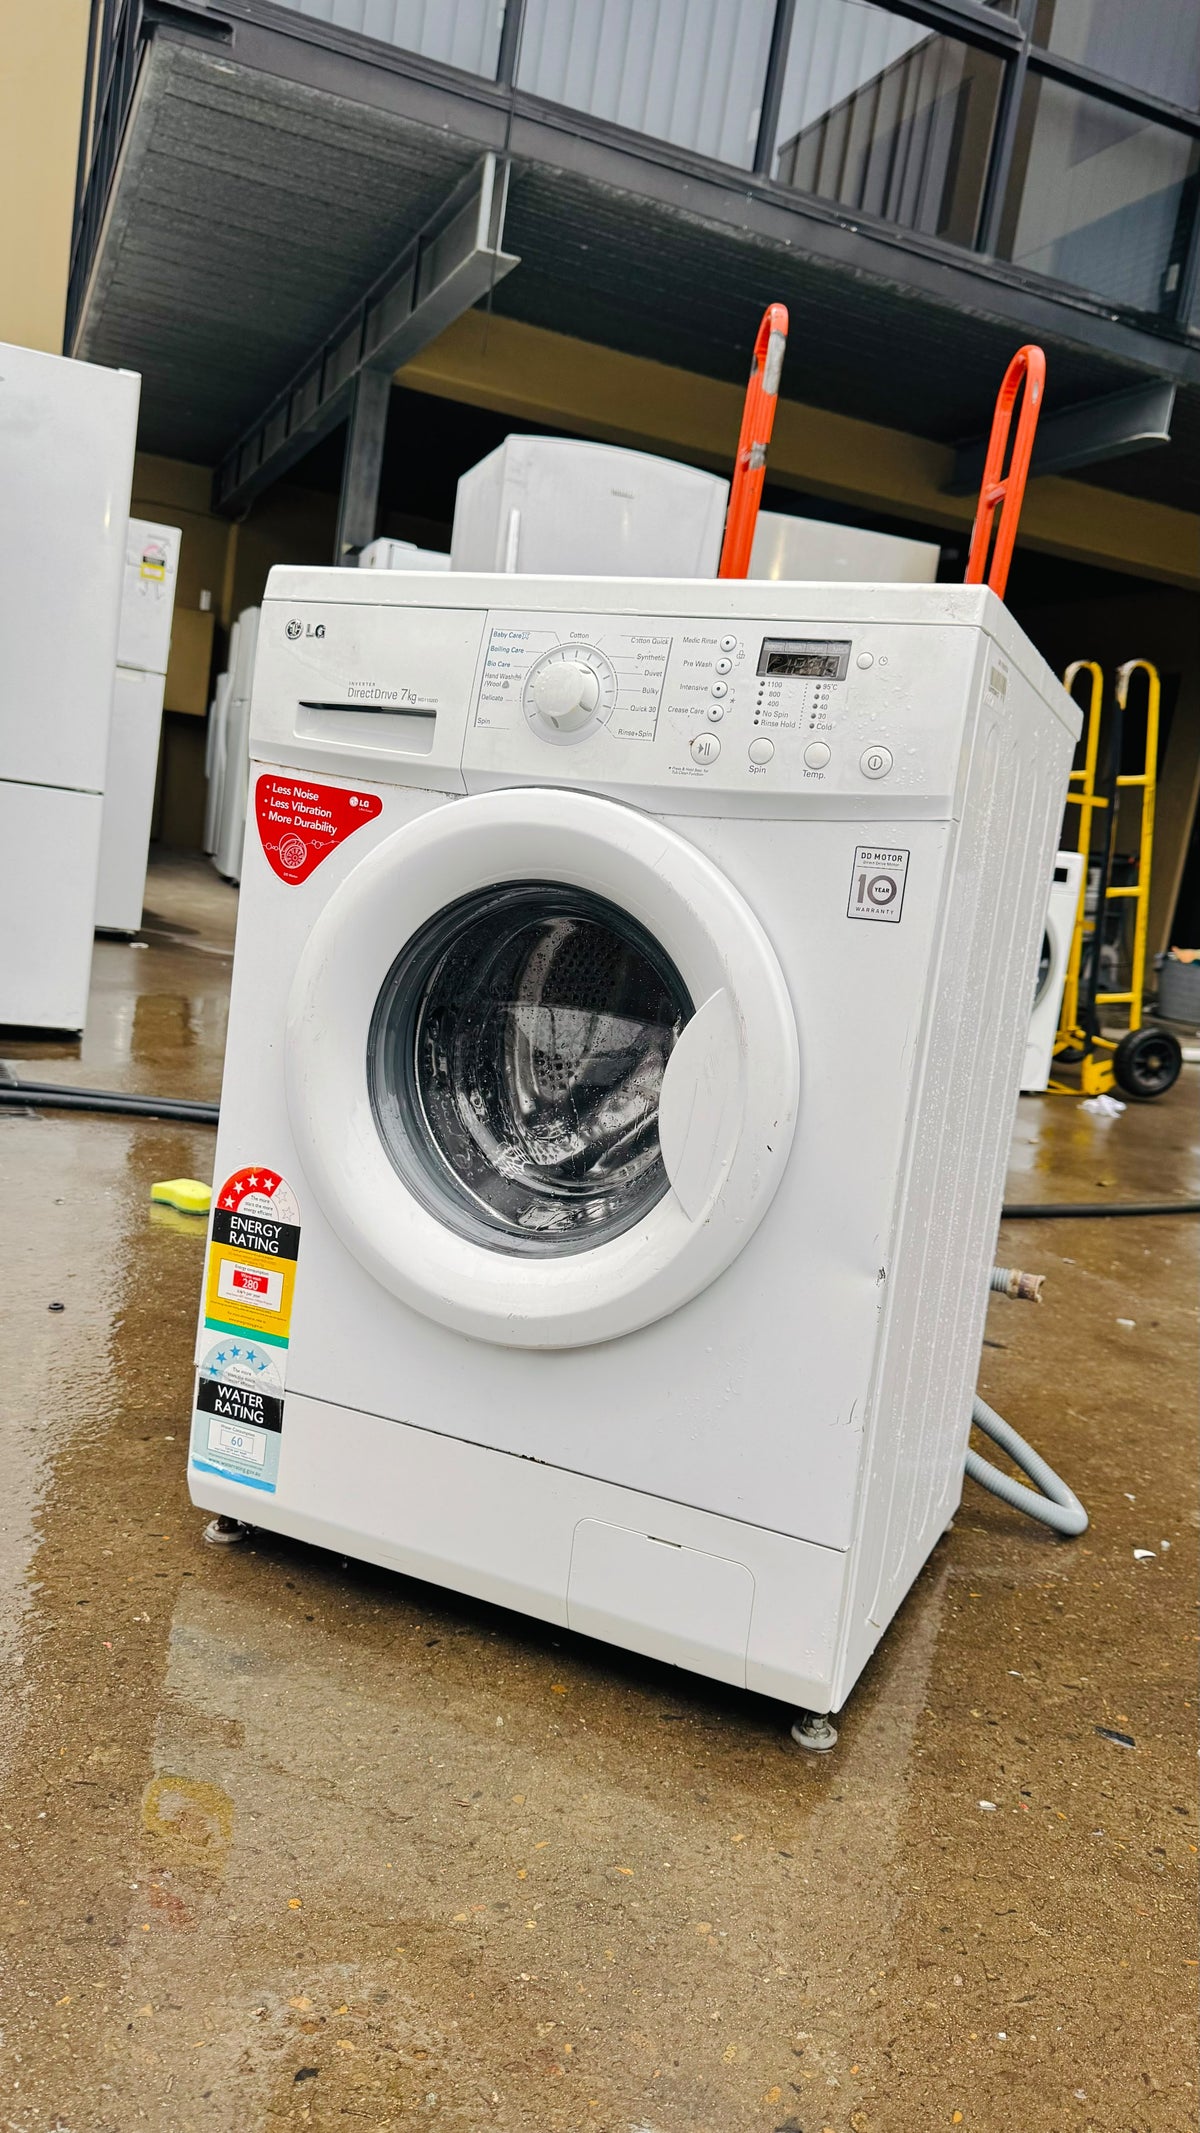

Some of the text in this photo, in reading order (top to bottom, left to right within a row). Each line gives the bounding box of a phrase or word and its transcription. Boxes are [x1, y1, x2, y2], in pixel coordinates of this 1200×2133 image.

[306, 623, 326, 638] LG
[490, 646, 510, 654] Boiling
[636, 654, 665, 662] Synthetic
[401, 688, 417, 704] 7kg
[642, 687, 659, 695] Bulky
[482, 694, 504, 702] Delicate
[618, 729, 652, 738] Rinse+Spin
[748, 764, 766, 774] Spin
[802, 770, 826, 780] Temp.
[272, 783, 319, 801] Less Noise
[270, 797, 332, 818] Less Vibration
[360, 800, 370, 808] LG
[268, 811, 338, 836] More Durability
[874, 854, 902, 862] MOTOR
[857, 874, 897, 906] 10
[856, 906, 894, 915] WARRANTY
[230, 1216, 282, 1238] ENERGY
[229, 1230, 279, 1254] RATING
[242, 1278, 259, 1291] 280
[217, 1384, 264, 1410] WATER
[214, 1398, 264, 1424] RATING
[231, 1436, 243, 1448] 60
